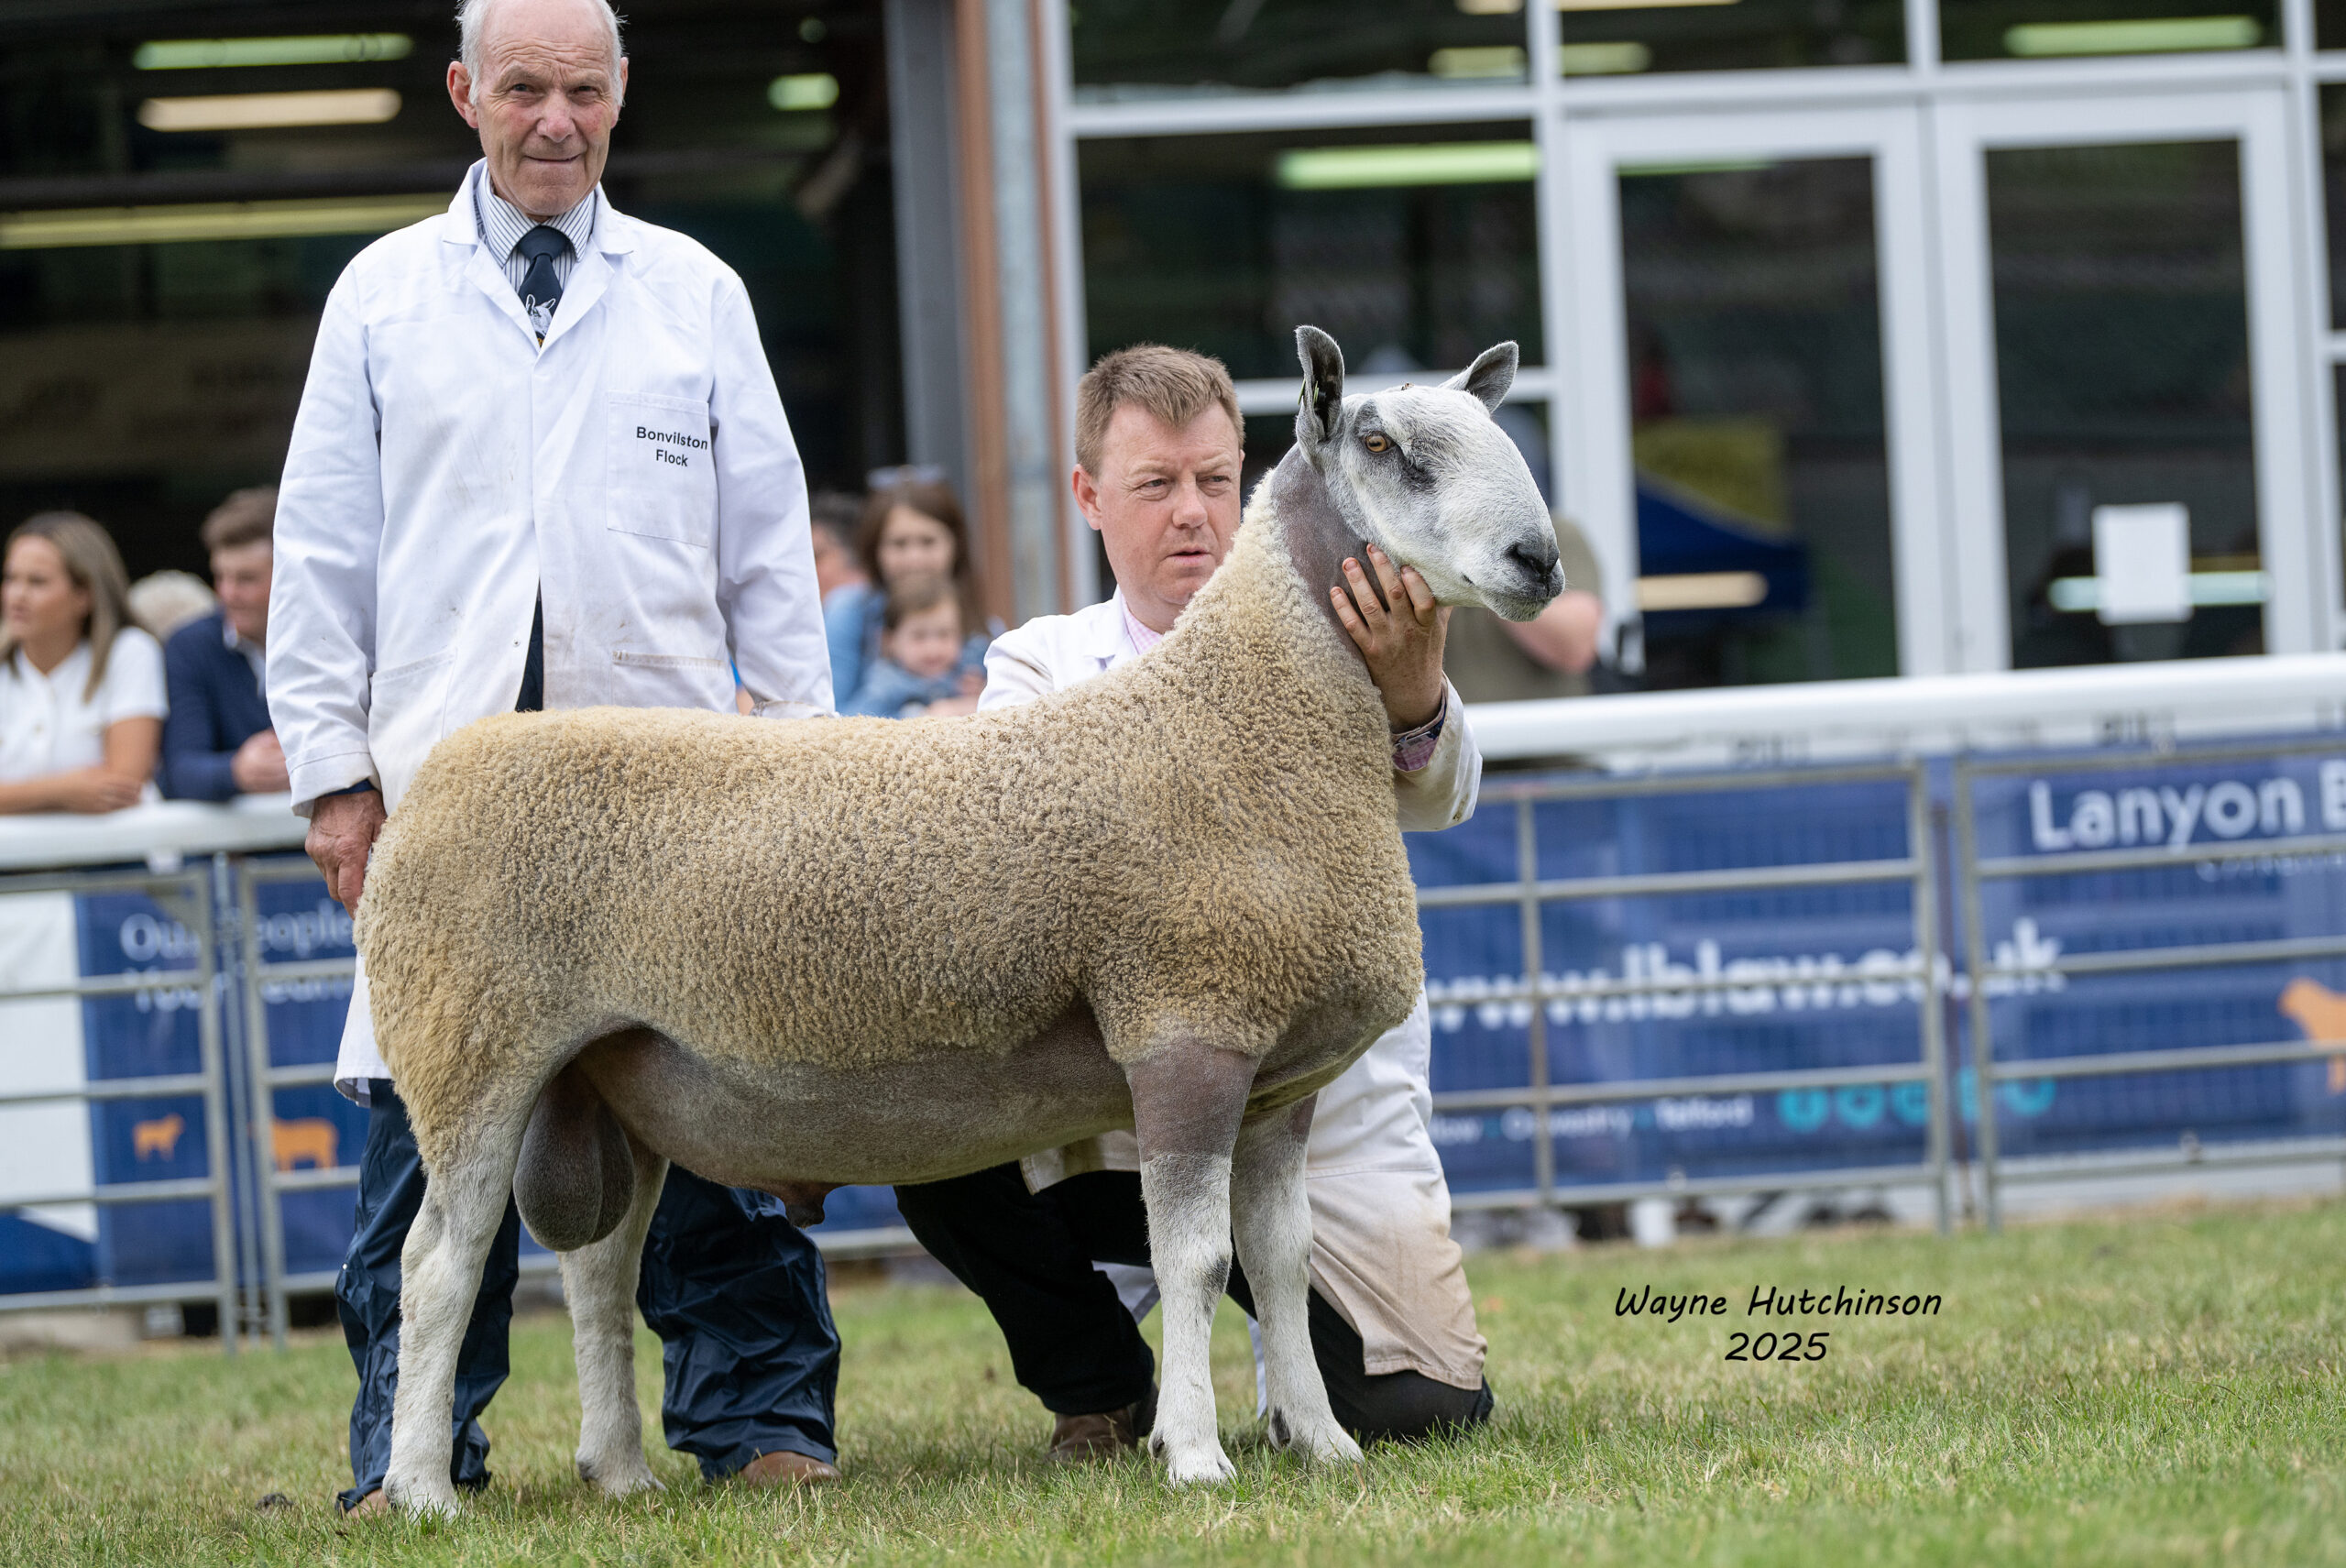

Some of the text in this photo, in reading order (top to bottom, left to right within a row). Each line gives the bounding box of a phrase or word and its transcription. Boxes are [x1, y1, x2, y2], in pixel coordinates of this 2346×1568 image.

[636, 426, 708, 450] Bonvilston
[655, 449, 689, 467] Flock
[2028, 777, 2306, 856] Lanyon
